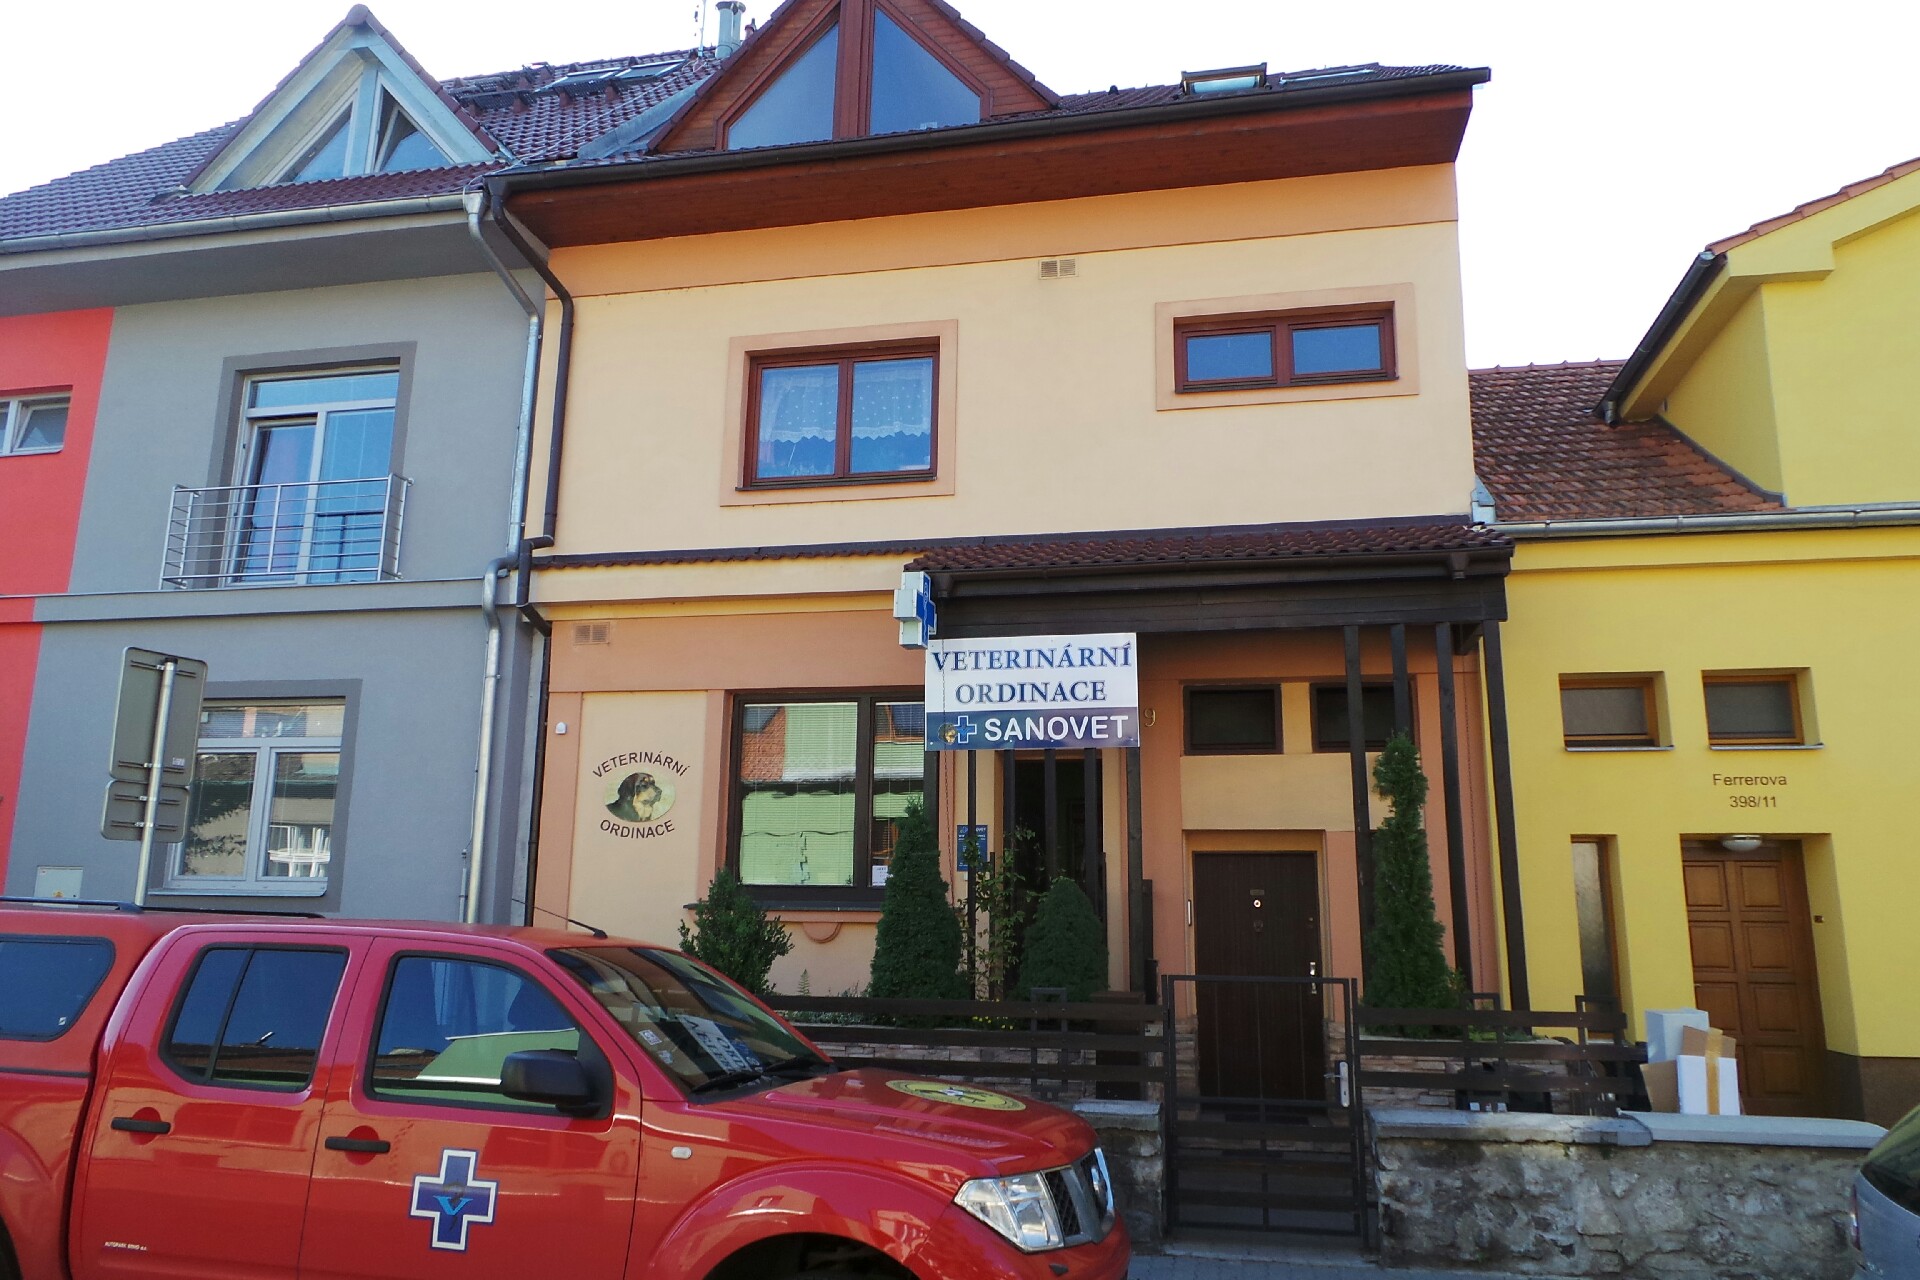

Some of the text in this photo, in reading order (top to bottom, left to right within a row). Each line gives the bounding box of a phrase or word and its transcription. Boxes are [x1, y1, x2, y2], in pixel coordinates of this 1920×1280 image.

[932, 641, 1132, 671] VETERINÁRNÍ
[955, 680, 1107, 704] ORDINACE
[1144, 708, 1156, 727] 9
[984, 715, 1129, 742] SANOVET
[592, 750, 690, 777] VETERINÁRNÍ
[1712, 773, 1787, 786] Ferrerova
[1729, 795, 1777, 808] 398/11
[600, 820, 675, 839] ORDINACE
